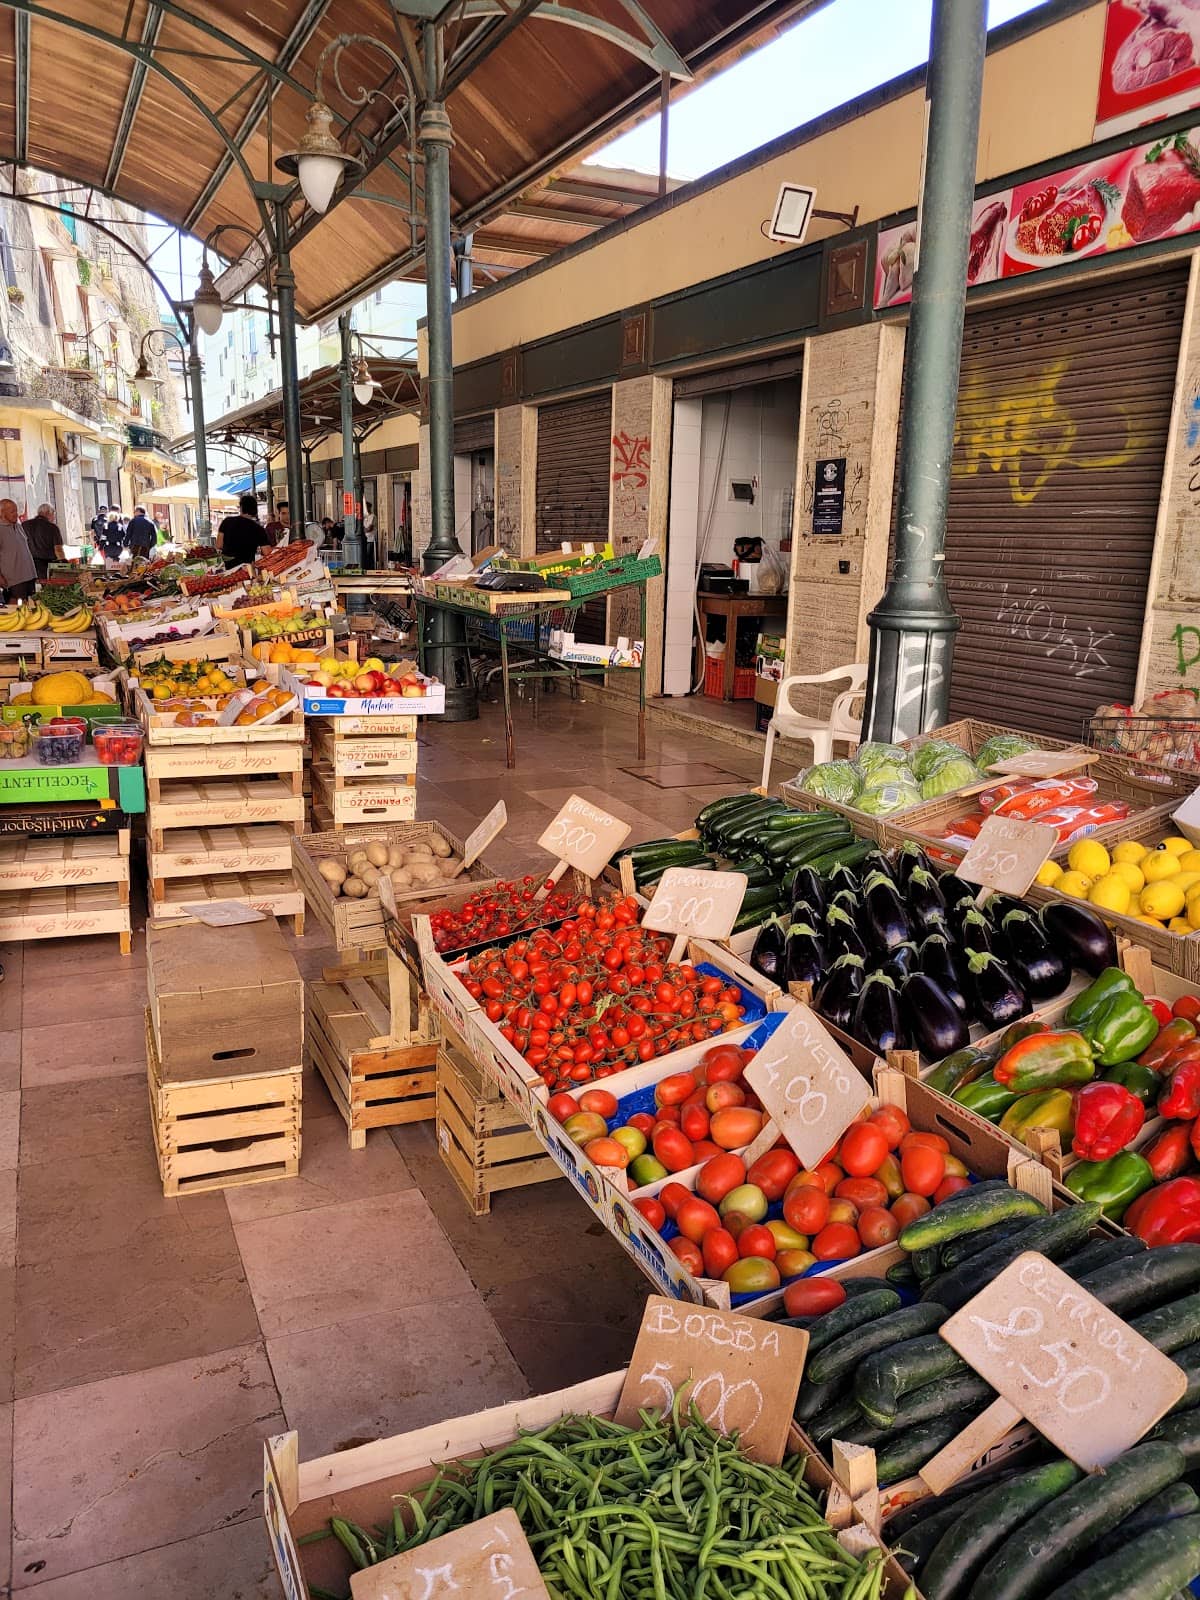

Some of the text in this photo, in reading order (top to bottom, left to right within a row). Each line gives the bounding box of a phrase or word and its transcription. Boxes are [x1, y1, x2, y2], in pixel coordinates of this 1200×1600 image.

[271, 629, 324, 643] TALARICO
[566, 651, 602, 663] Stravato
[347, 751, 399, 761] PANNOZZO
[0, 775, 89, 789] ECCELLENT
[350, 796, 401, 807] PANNOZZO
[0, 818, 89, 832] AntichiSapor
[646, 1304, 781, 1358] BOBBA
